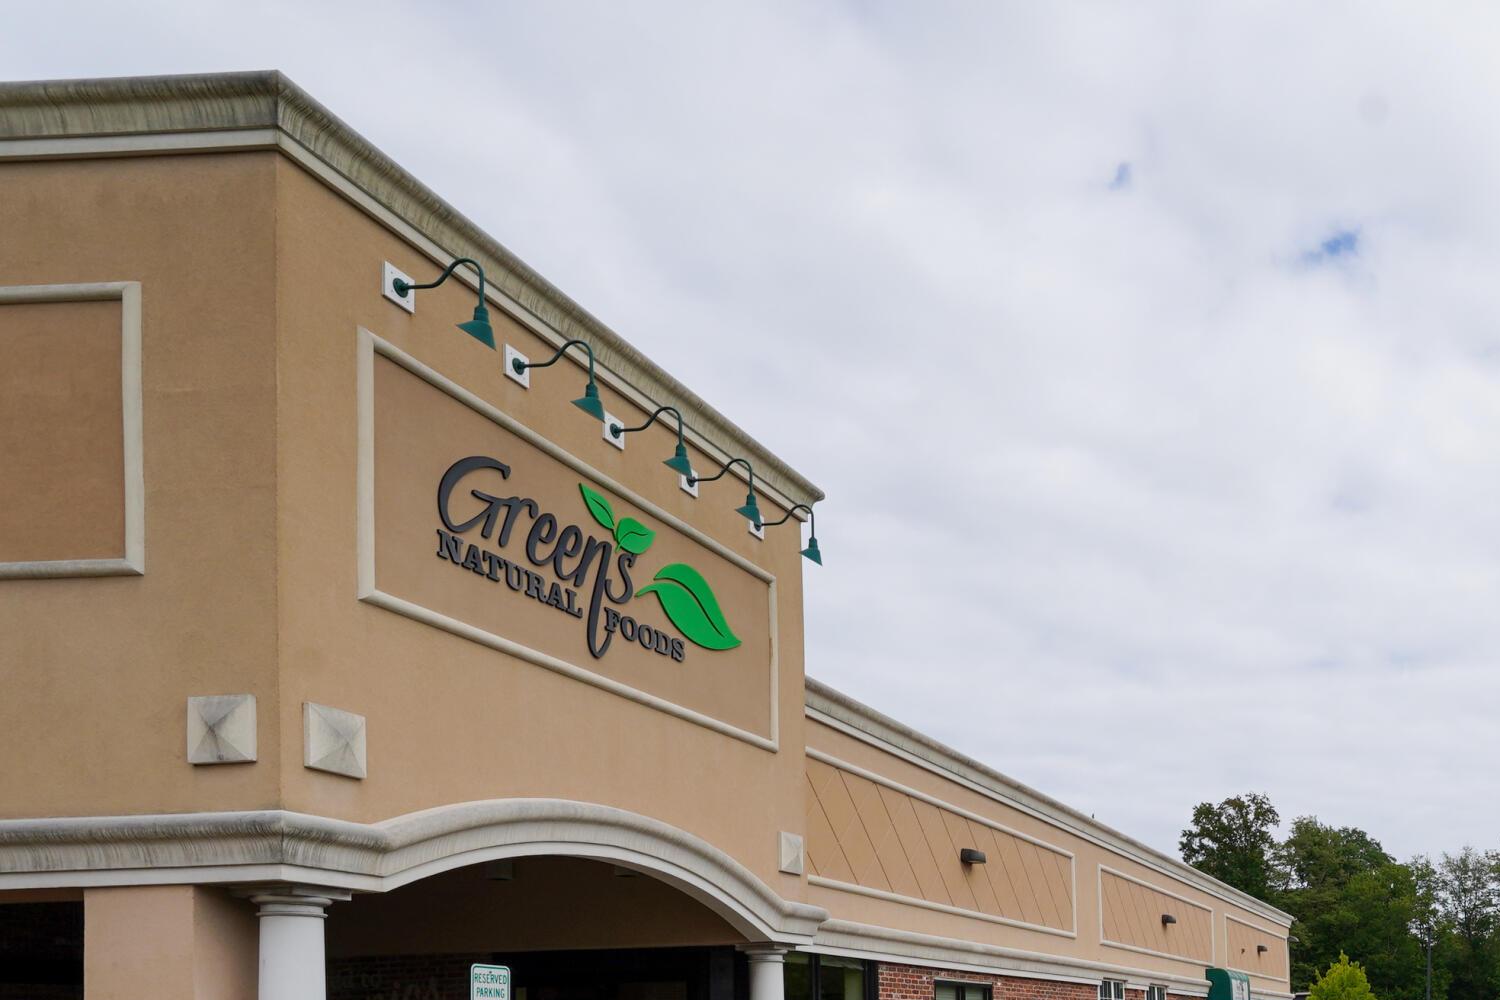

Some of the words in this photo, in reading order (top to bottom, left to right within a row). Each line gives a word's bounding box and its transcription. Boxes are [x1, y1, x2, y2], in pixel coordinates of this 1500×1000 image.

[437, 455, 637, 659] Greens
[437, 529, 583, 619] NATURAL
[604, 607, 686, 663] FOODS
[474, 972, 508, 985] RESERVED
[476, 986, 505, 999] PARKING
